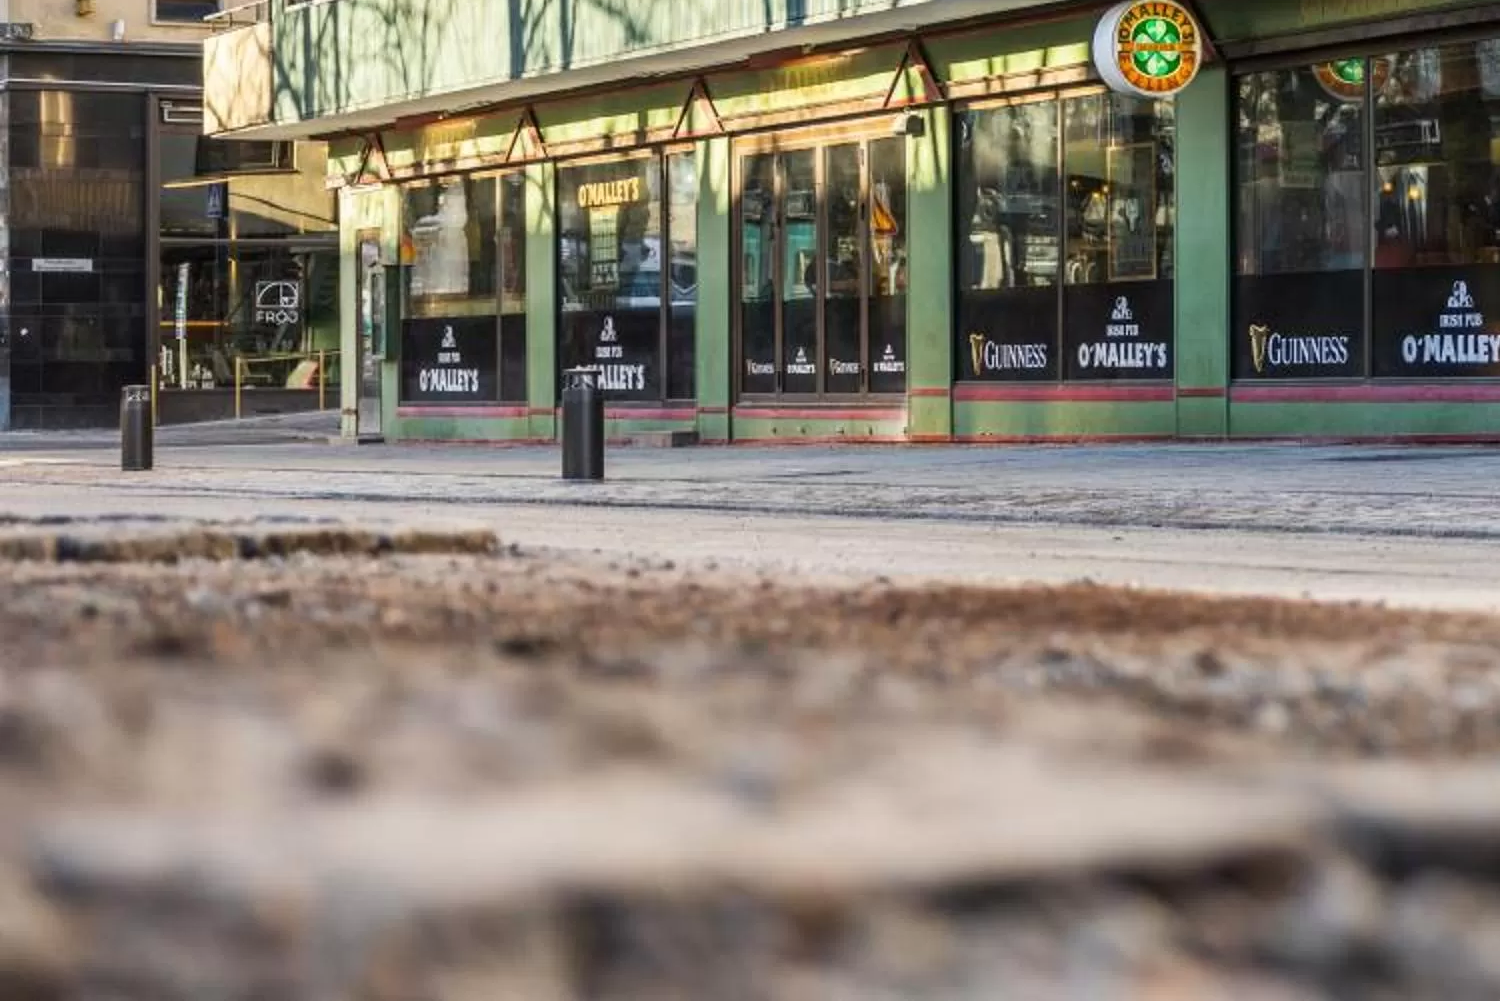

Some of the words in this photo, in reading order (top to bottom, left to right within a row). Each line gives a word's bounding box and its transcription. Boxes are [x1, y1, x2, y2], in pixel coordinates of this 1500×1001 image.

[578, 177, 639, 207] O'MALLEY'S
[984, 340, 1047, 369] GUINNESS
[1078, 343, 1167, 369] O'MALLEY'S
[1268, 332, 1349, 365] GUINNESS
[575, 363, 645, 391] ALLEY'S
